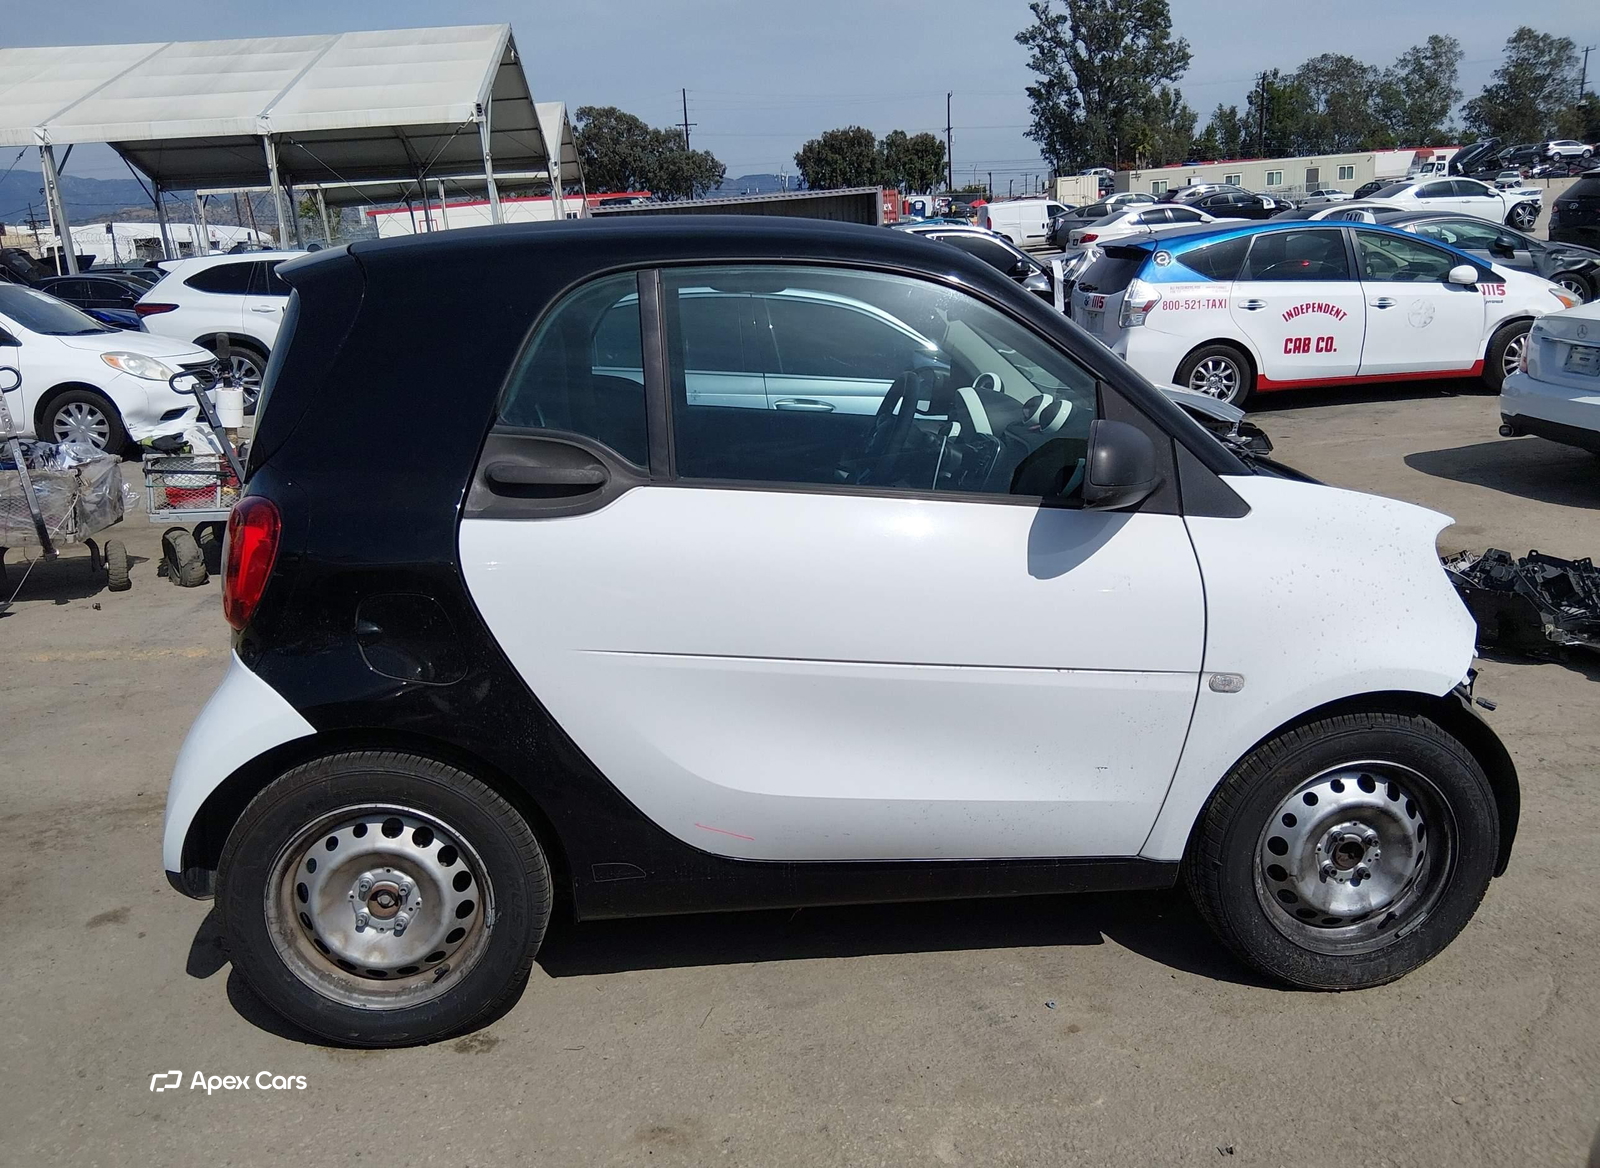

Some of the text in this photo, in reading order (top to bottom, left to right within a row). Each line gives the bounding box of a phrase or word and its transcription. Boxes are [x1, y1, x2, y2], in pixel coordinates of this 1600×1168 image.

[1481, 284, 1506, 296] 1115
[1162, 299, 1227, 311] 800-521-TAXI
[1282, 302, 1347, 322] INDEPENDENT
[1283, 336, 1337, 354] CAB CO.
